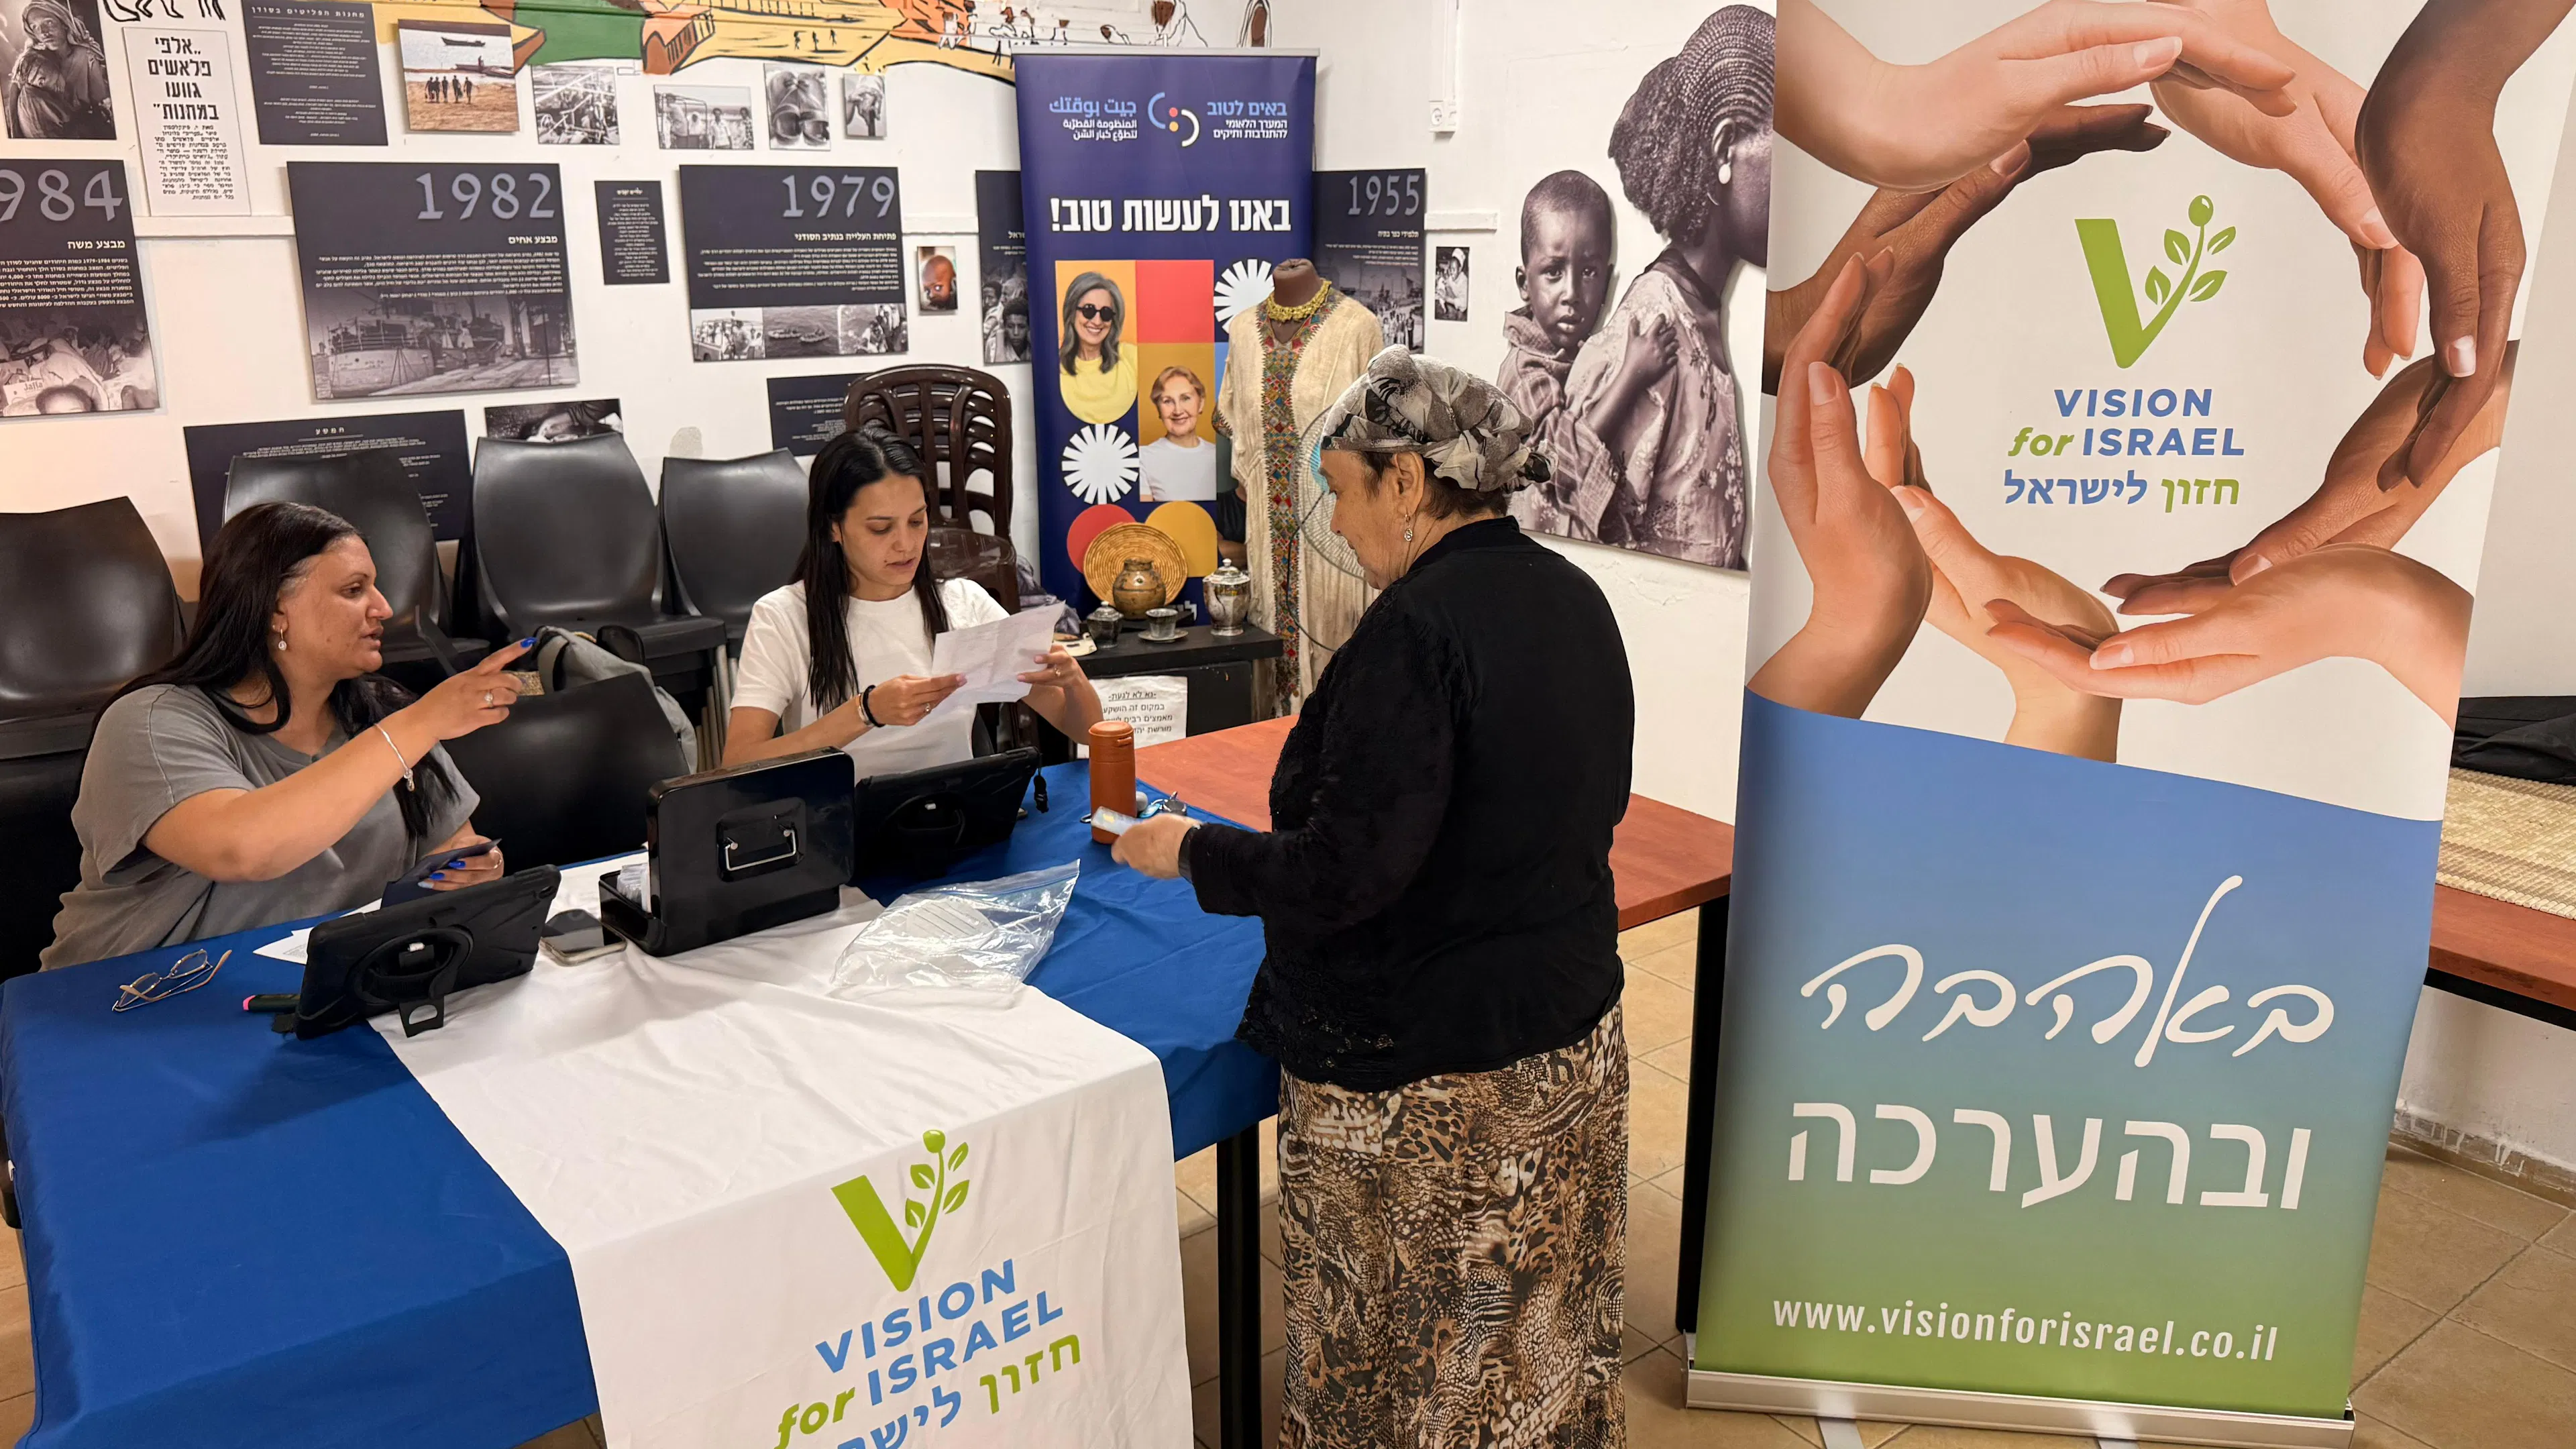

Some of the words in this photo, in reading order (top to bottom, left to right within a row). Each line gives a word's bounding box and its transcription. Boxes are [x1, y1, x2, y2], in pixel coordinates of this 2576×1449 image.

[148, 58, 212, 76] פלאשים
[166, 81, 202, 98] גוועו
[1049, 96, 1100, 118] بوقتك
[1104, 99, 1137, 117] جيت
[1207, 100, 1244, 115] לטוב
[1248, 102, 1287, 116] באים
[1097, 119, 1138, 131] المنظومة
[1226, 119, 1256, 129] הלאומי
[1258, 119, 1288, 132] המערך
[1095, 129, 1112, 141] كبار
[1213, 129, 1242, 140] ותיקים
[1244, 129, 1288, 139] להתנדבות
[416, 172, 555, 221] 1982
[782, 174, 895, 219] 1979
[1348, 174, 1420, 217] 1955
[1051, 197, 1112, 231] טוב!
[1122, 194, 1220, 231] לעשות
[1229, 199, 1291, 231] באנו
[67, 240, 93, 250] משה
[96, 240, 125, 250] מבצע
[508, 235, 533, 244] אחים
[535, 235, 558, 244] מבצע
[2054, 388, 2212, 417] VISION
[2008, 427, 2073, 457] for
[2083, 428, 2245, 456] ISRAEL
[2004, 469, 2148, 505] לישראל
[2161, 477, 2240, 513] חזון
[1132, 691, 1142, 699] לא
[1103, 705, 1127, 715] הושקע
[1141, 704, 1165, 712] במקום
[1144, 714, 1173, 722] מאמצים
[1148, 726, 1172, 734] מורשת
[1800, 874, 2334, 1068] באהבה
[1788, 1102, 2312, 1210] ובהערכה
[815, 1258, 1016, 1374] VISION
[1772, 1298, 2278, 1362] www.visionforisrael.co.il
[773, 1386, 856, 1449] for
[867, 1291, 1063, 1407] ISRAEL
[980, 1334, 1081, 1414] חזון
